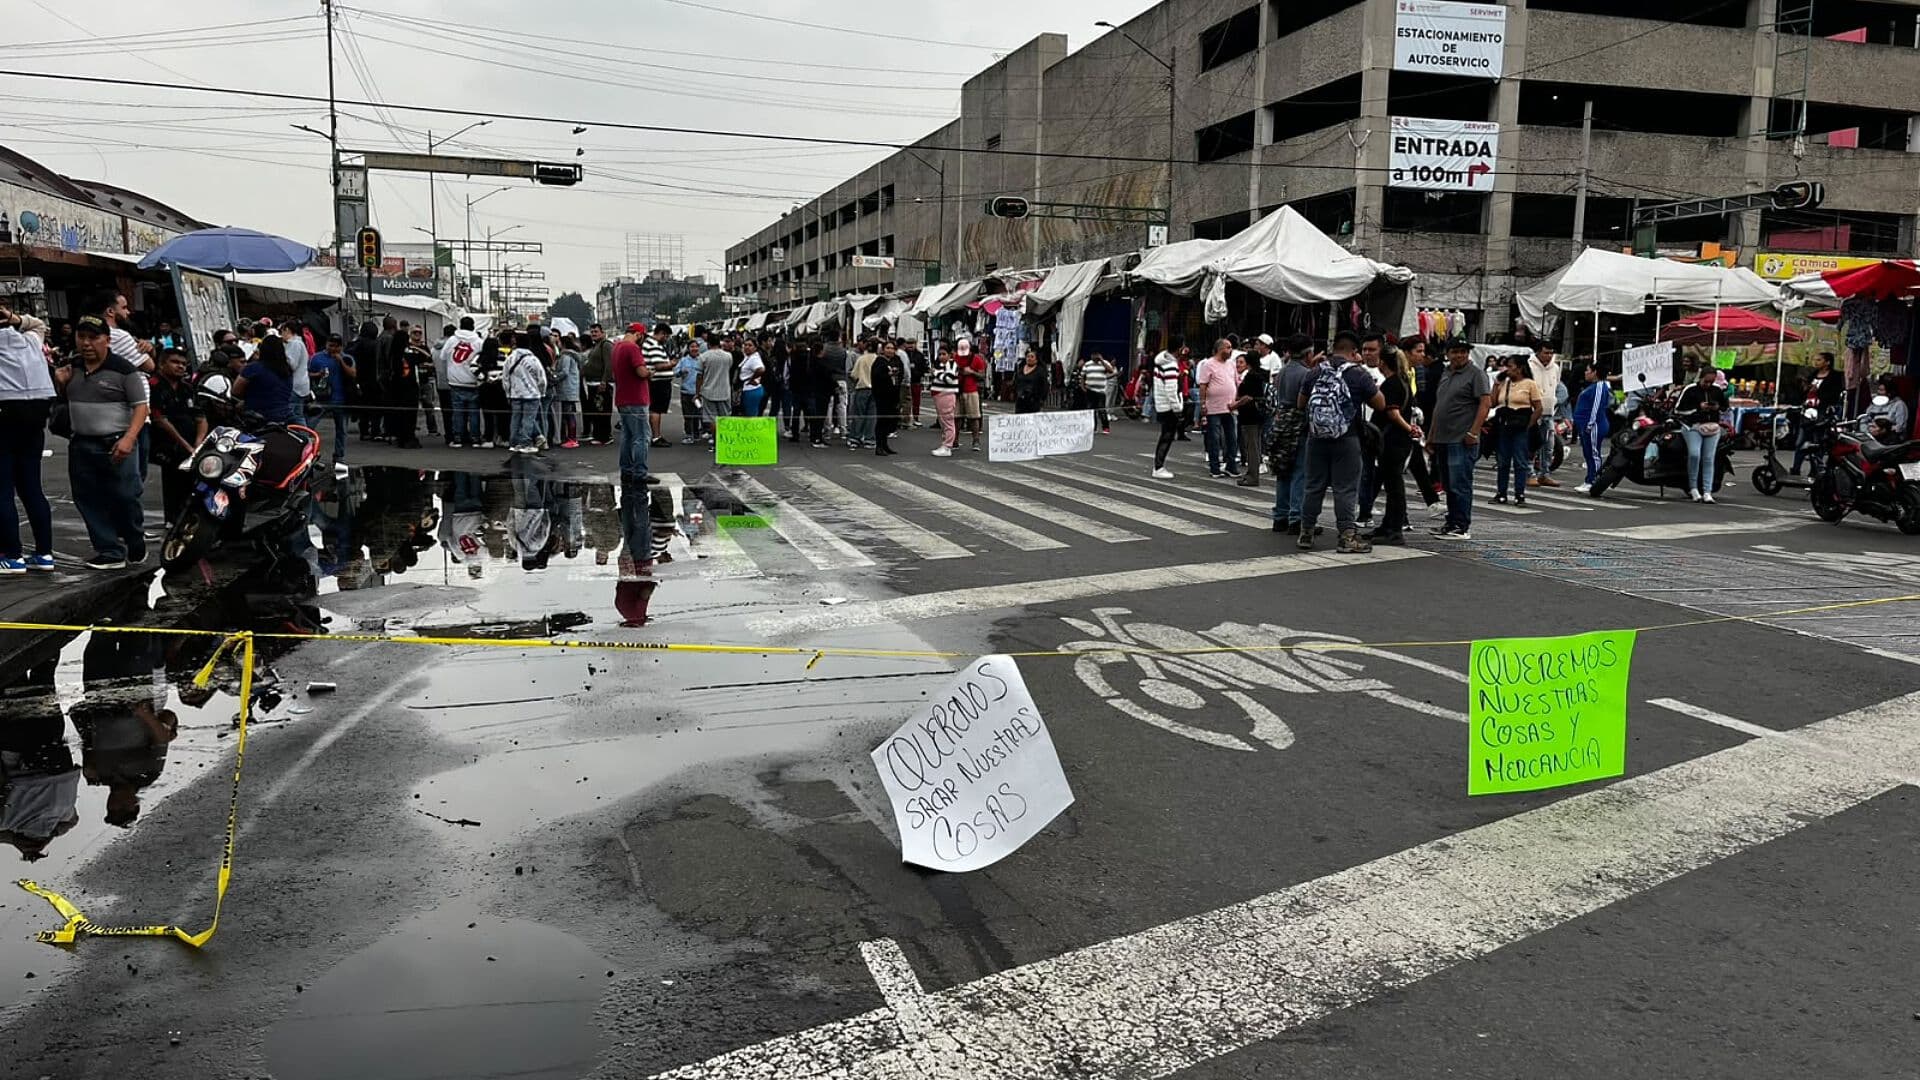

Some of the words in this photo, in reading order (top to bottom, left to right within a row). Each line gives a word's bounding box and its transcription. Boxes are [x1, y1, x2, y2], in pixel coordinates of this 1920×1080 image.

[1470, 8, 1503, 17] SERVIMET
[1397, 27, 1503, 44] ESTACIONAMIENTO
[1442, 43, 1458, 53] DE
[1408, 54, 1490, 68] AUTOSERVICIO
[1394, 136, 1492, 158] ENTRADA
[1393, 168, 1404, 181] a
[1410, 165, 1463, 183] 100m
[1476, 639, 1617, 686] QUEREMOS
[1479, 678, 1599, 716] NUESTRAS
[1481, 716, 1555, 747] COSAS
[1569, 711, 1580, 744] Y
[905, 778, 959, 829] SACAR
[957, 706, 1041, 784] NUESTRAS
[1484, 737, 1601, 782] MERCANCIA
[933, 782, 1027, 862] COSAS
